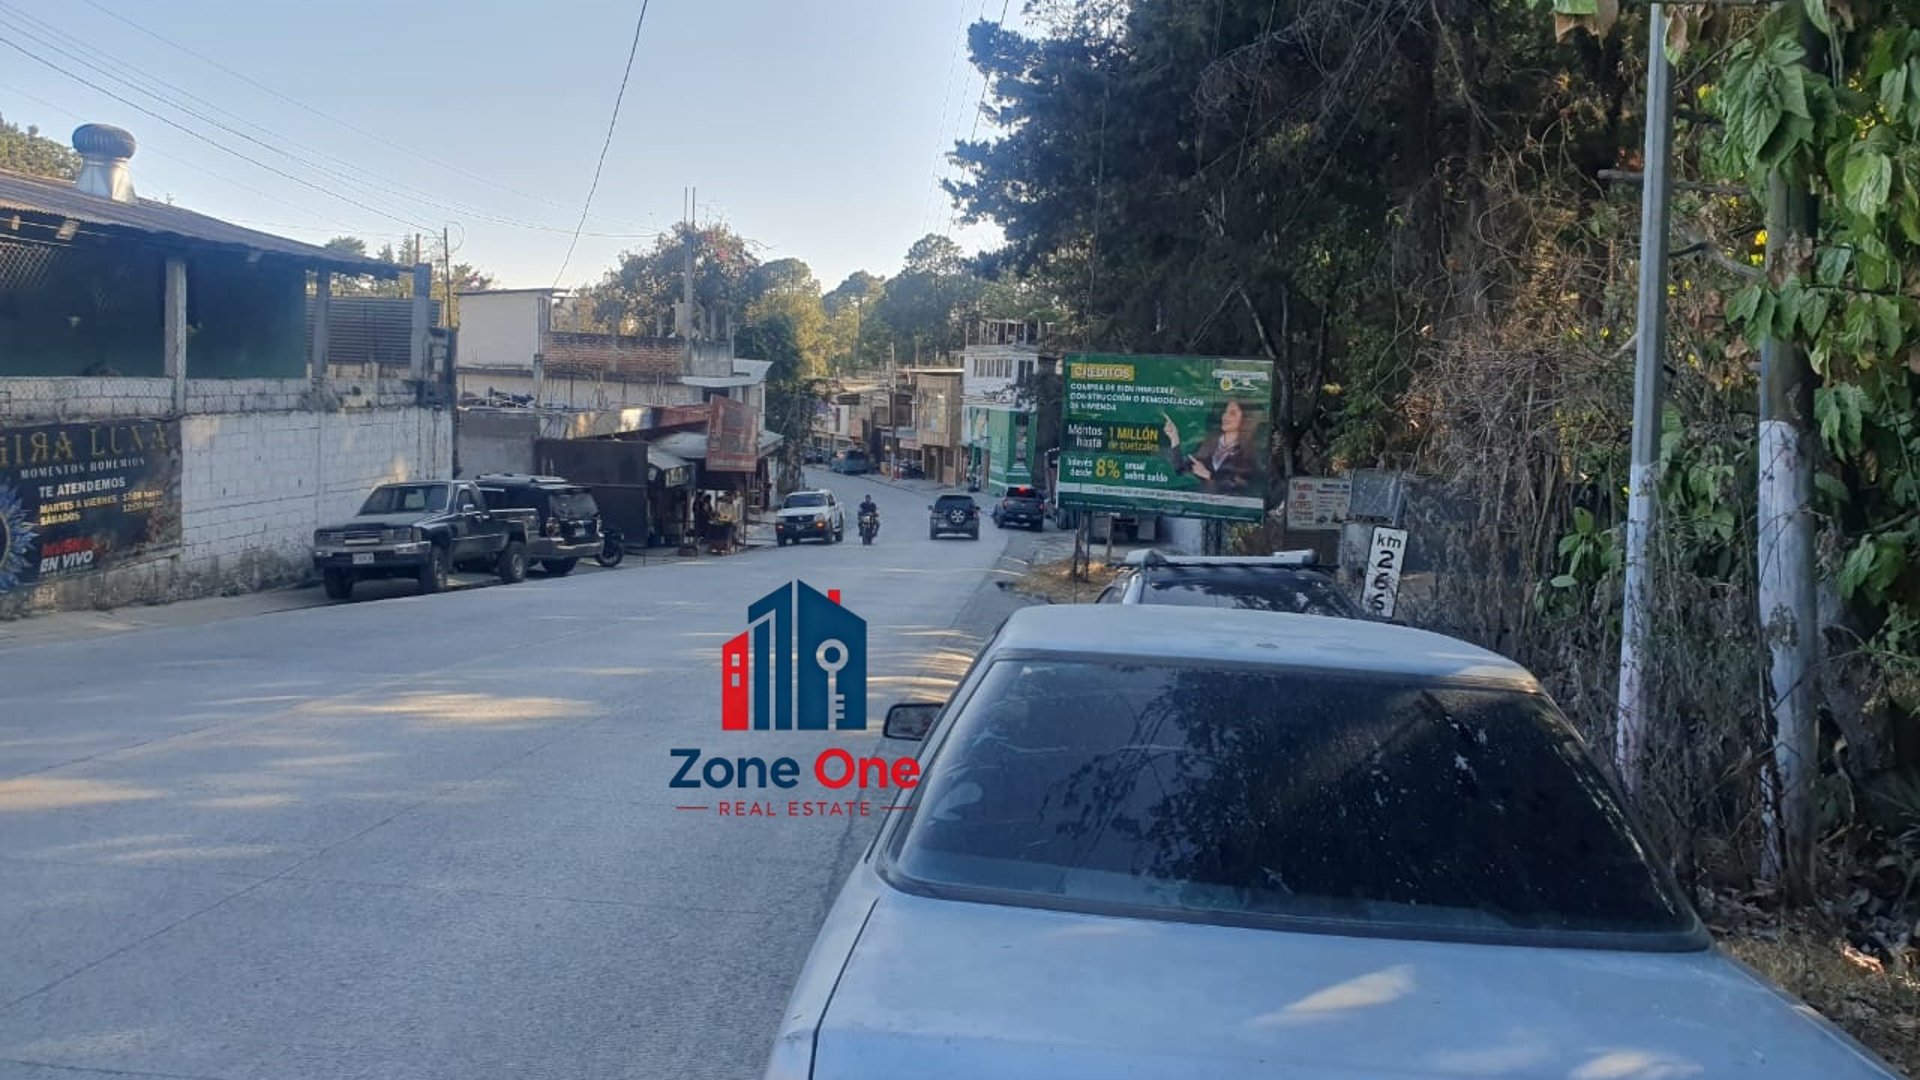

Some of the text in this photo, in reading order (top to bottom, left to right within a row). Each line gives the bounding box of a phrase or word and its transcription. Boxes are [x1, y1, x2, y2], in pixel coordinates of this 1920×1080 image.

[1133, 395, 1140, 403] O
[1068, 423, 1104, 436] Montos
[1117, 425, 1159, 441] MILLÓN
[1076, 436, 1102, 448] hasta
[20, 463, 85, 479] MOMENTOS
[1095, 458, 1120, 478] 8%
[39, 477, 126, 499] TE ATENDEMOS
[40, 501, 75, 514] MARTES
[1376, 533, 1402, 549] km
[40, 556, 60, 573] EN
[62, 549, 94, 568] VIVO
